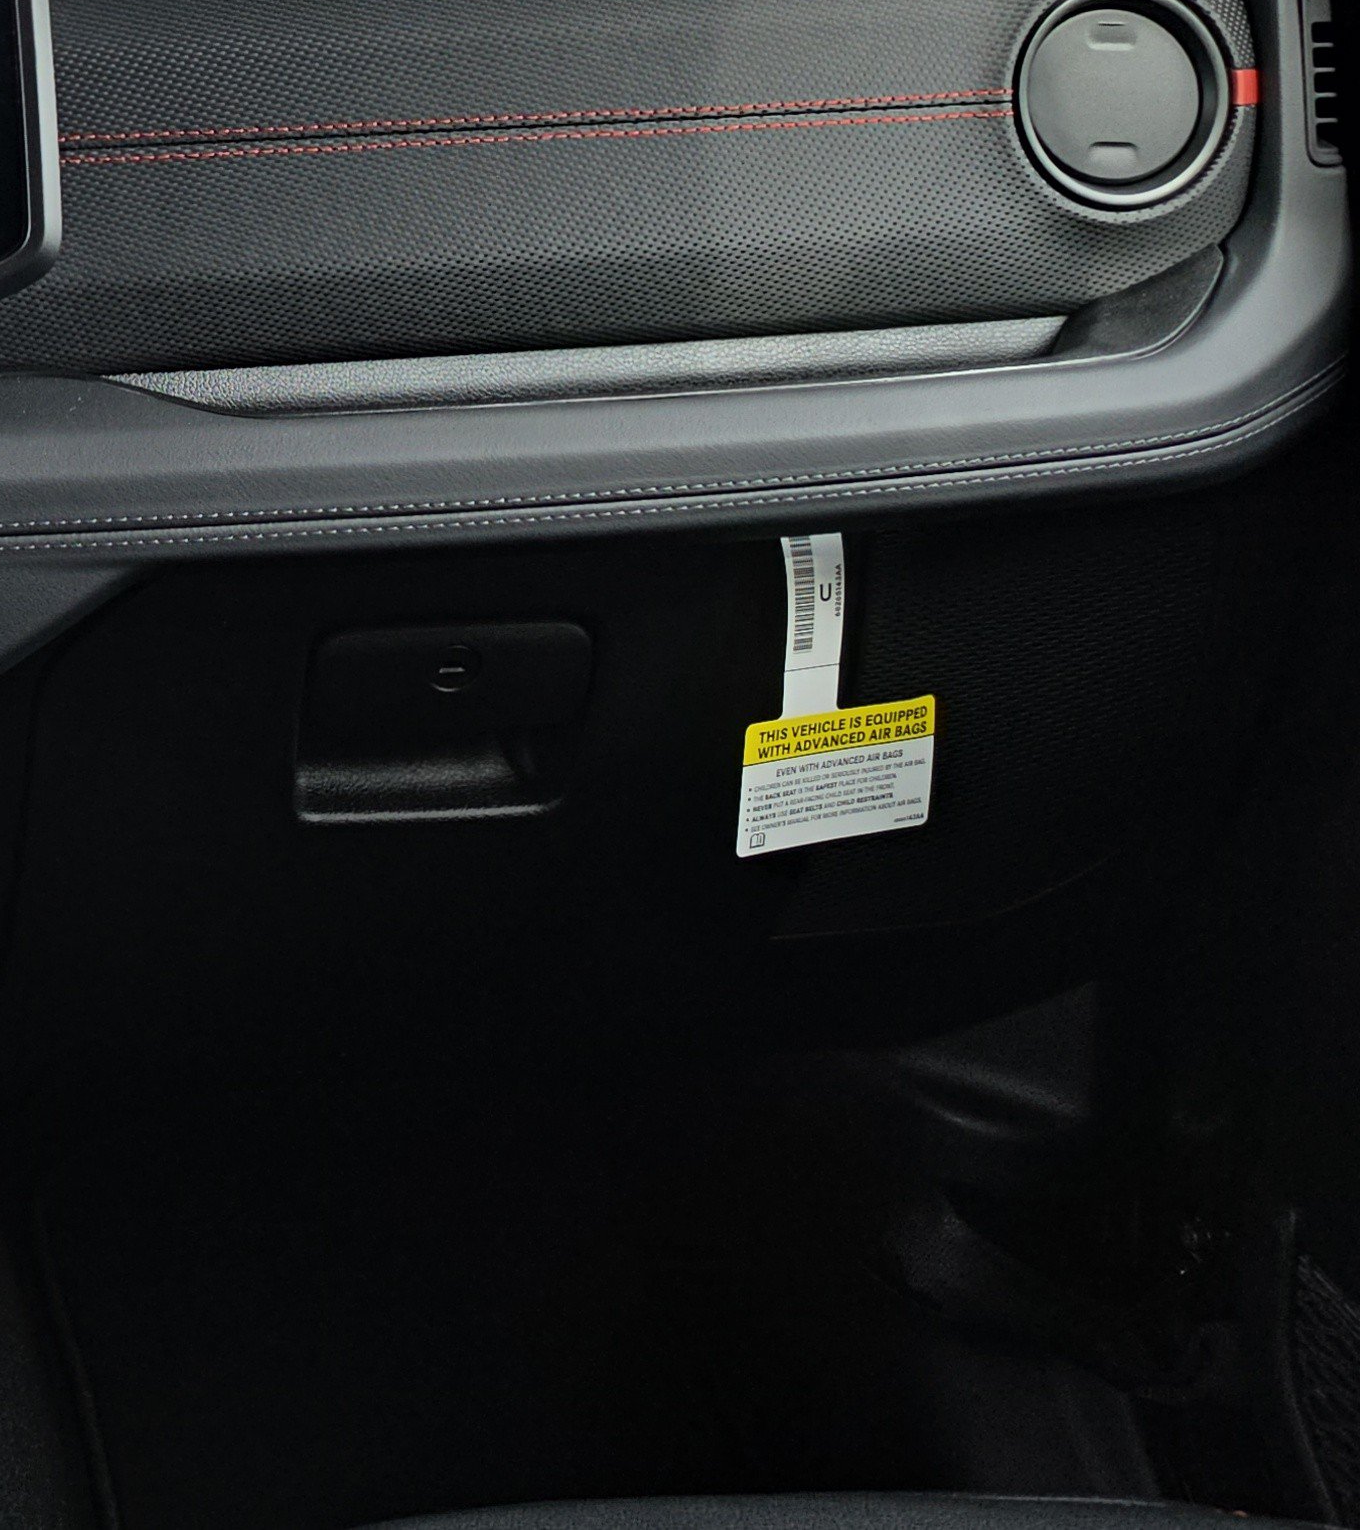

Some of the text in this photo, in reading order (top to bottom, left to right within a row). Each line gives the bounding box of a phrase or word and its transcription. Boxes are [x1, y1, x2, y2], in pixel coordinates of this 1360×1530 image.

[820, 583, 831, 601] U
[758, 722, 927, 759] WITH ADVANCED AIR BAGS
[759, 706, 927, 743] THIS VEHICLE IS EQUIPPED
[776, 750, 903, 777] EVEN WITH ADVANCED AIR BAGS
